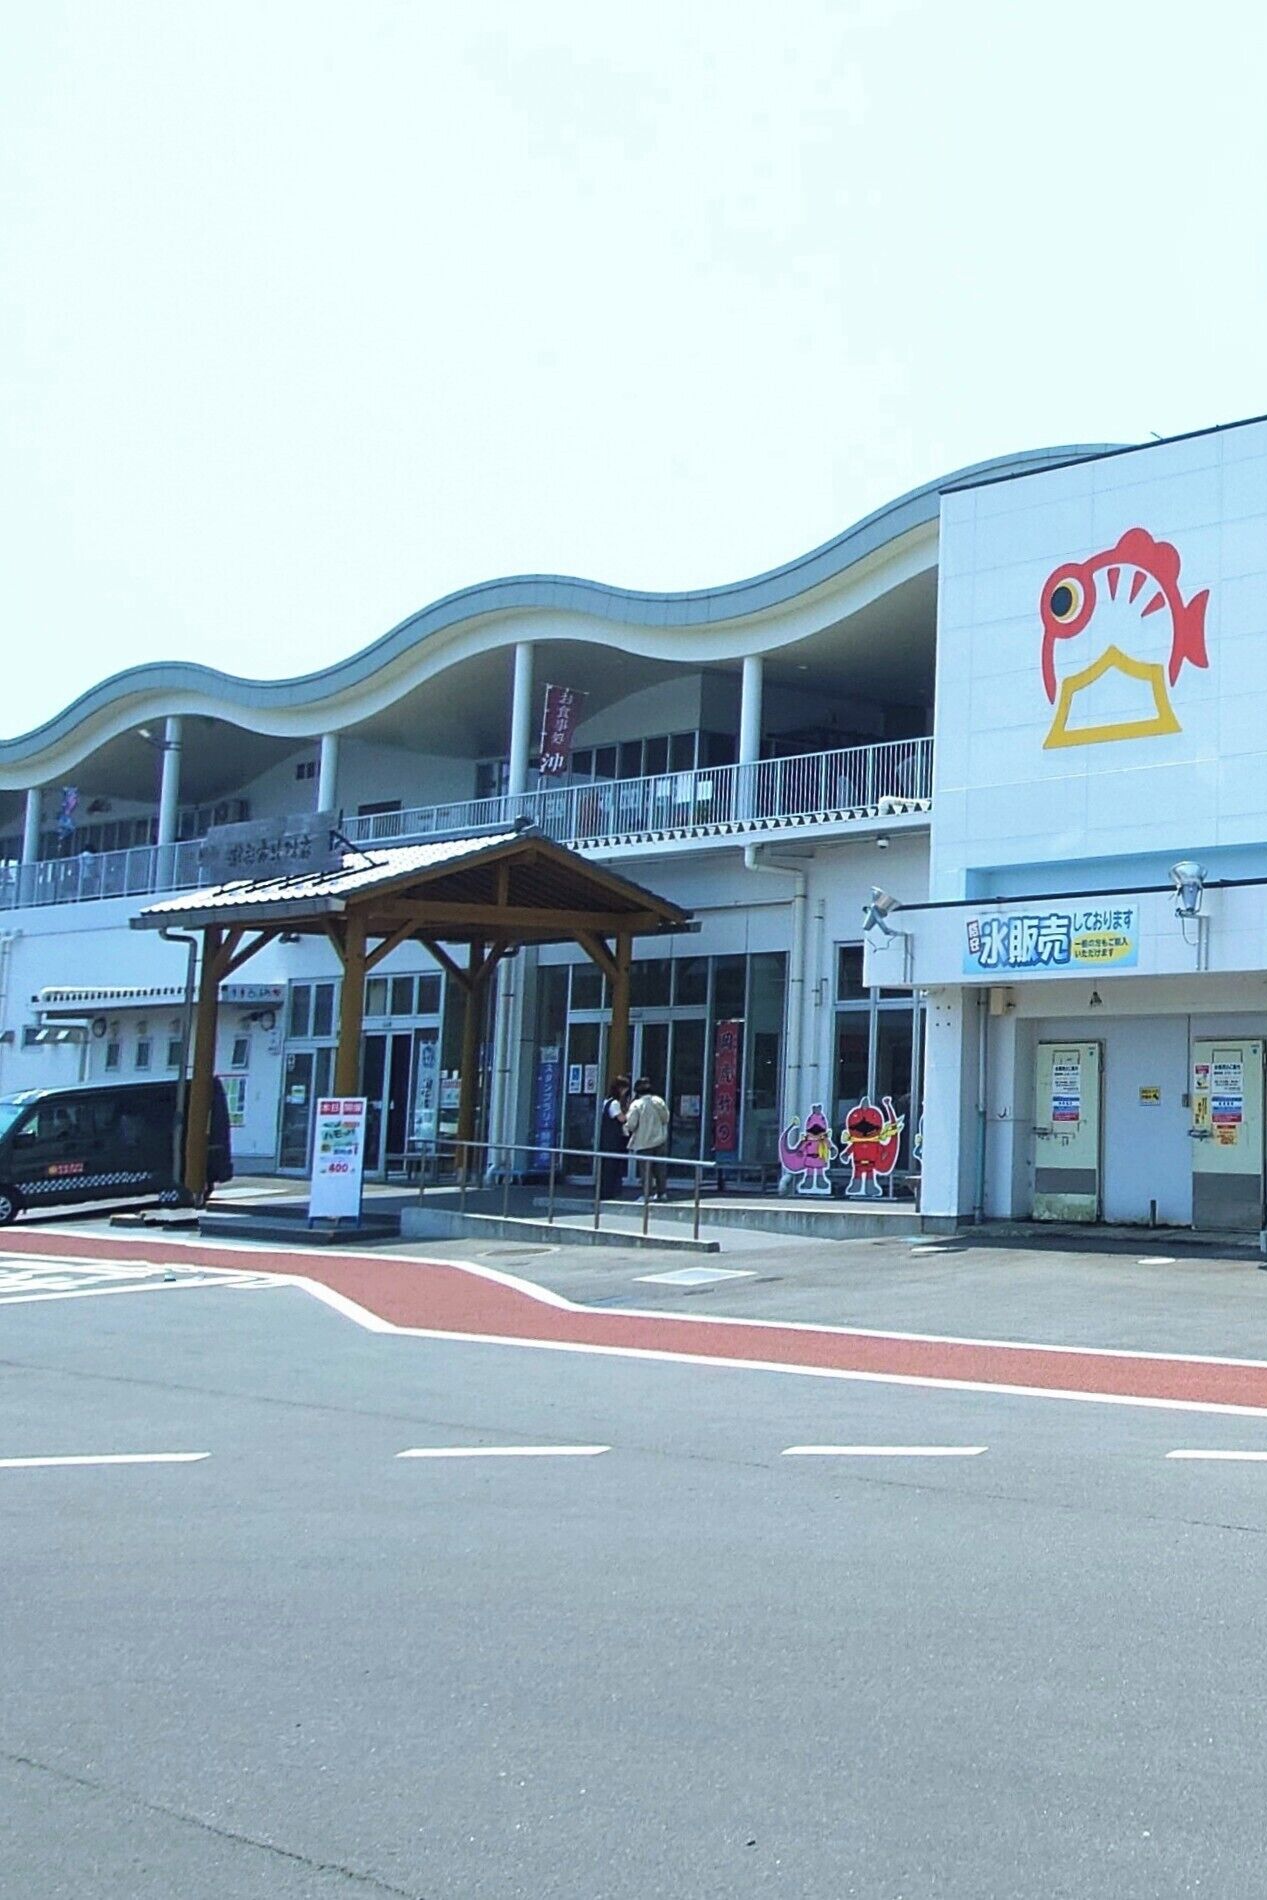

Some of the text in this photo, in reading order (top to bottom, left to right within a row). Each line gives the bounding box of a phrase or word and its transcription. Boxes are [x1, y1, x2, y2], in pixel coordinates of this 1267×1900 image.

[540, 753, 564, 772] 沖
[1073, 910, 1133, 931] しております
[980, 914, 1071, 967] 氷販売
[328, 1163, 349, 1173] 400
